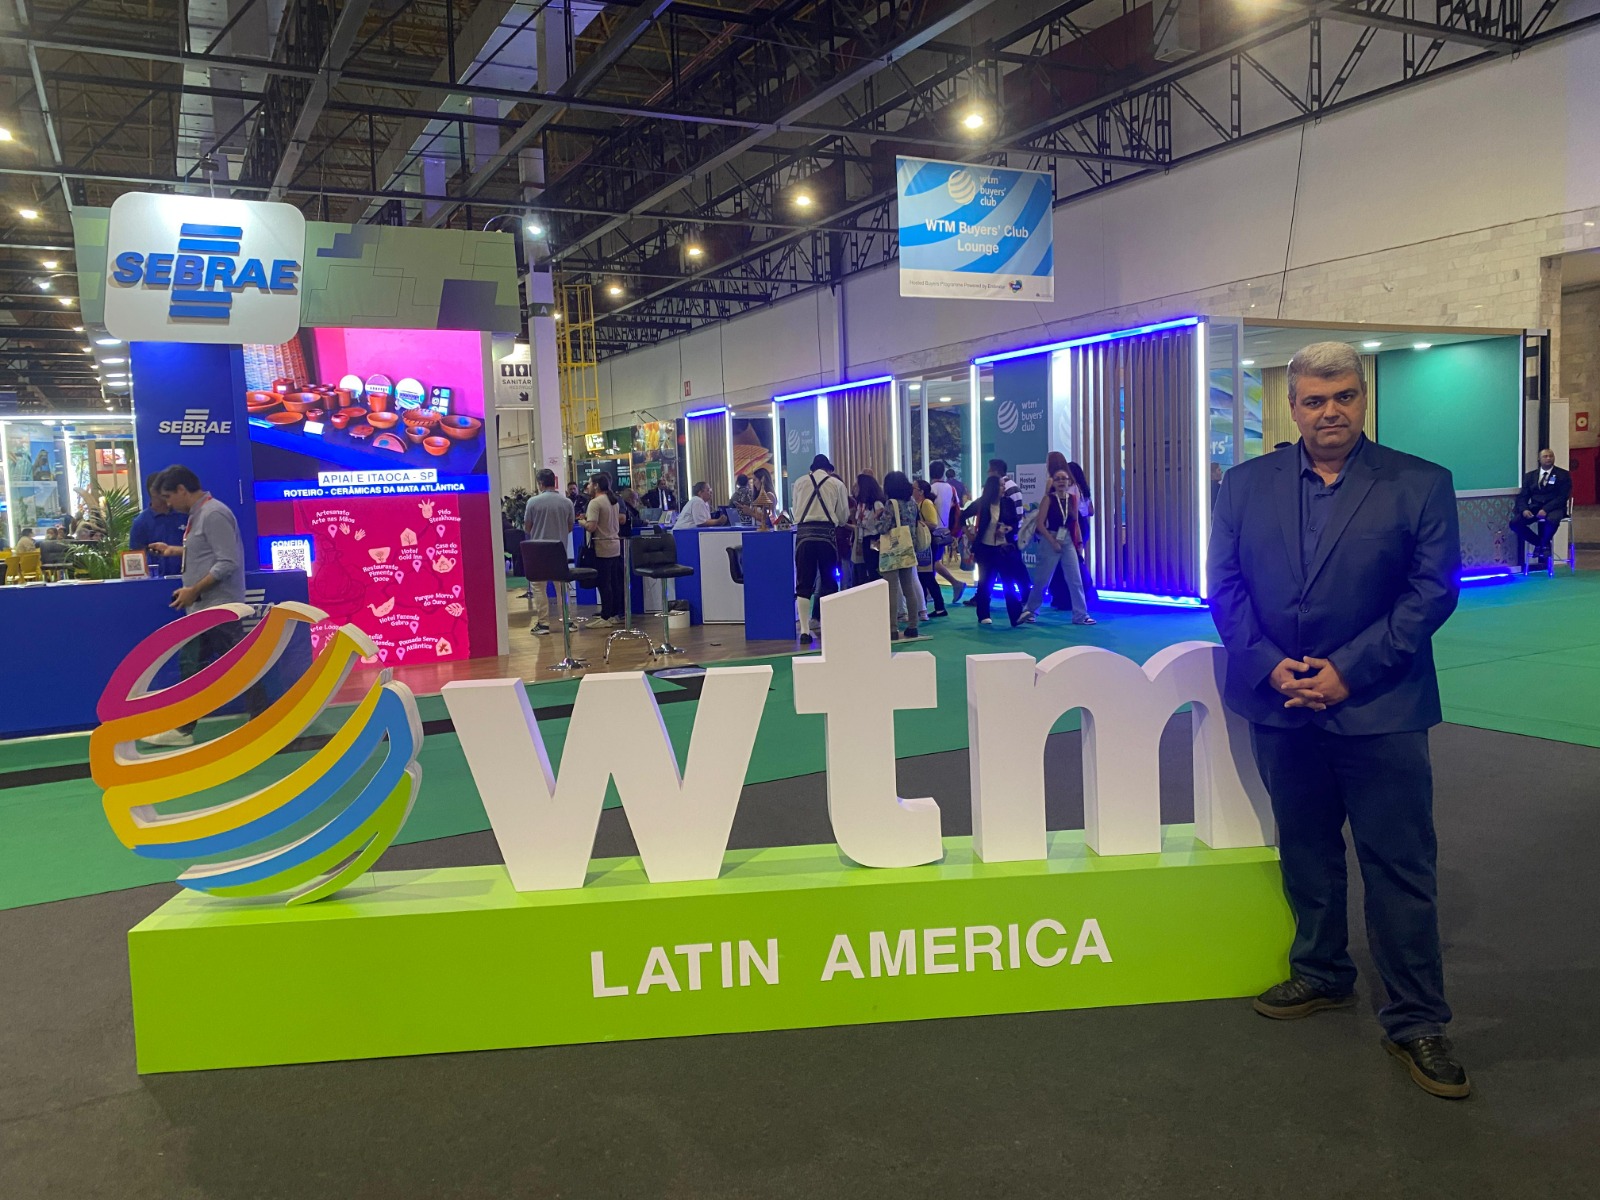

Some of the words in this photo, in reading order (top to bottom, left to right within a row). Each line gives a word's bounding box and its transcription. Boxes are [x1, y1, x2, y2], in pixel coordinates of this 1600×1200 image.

[979, 175, 999, 184] wtm
[980, 196, 997, 207] club
[925, 219, 956, 233] WTM
[959, 221, 1001, 237] Buyers'
[1004, 225, 1029, 238] Club
[957, 239, 999, 255] Lounge
[112, 251, 299, 290] SEBRAE
[1021, 400, 1037, 409] wtm
[158, 420, 232, 434] SEBRAE
[1021, 422, 1036, 432] club
[357, 474, 364, 482] E
[368, 472, 410, 482] ITAOCA
[420, 472, 434, 480] SP
[283, 488, 324, 497] ROTEIRO
[330, 486, 381, 496] CERÂMICAS
[397, 485, 419, 493] MATA
[420, 483, 465, 492] ATLÂNTICA
[429, 515, 461, 523] Steakhouse
[415, 594, 434, 602] Parque
[441, 579, 1279, 893] wtm
[590, 938, 780, 998] LATIN
[820, 918, 1113, 981] AMERICA
